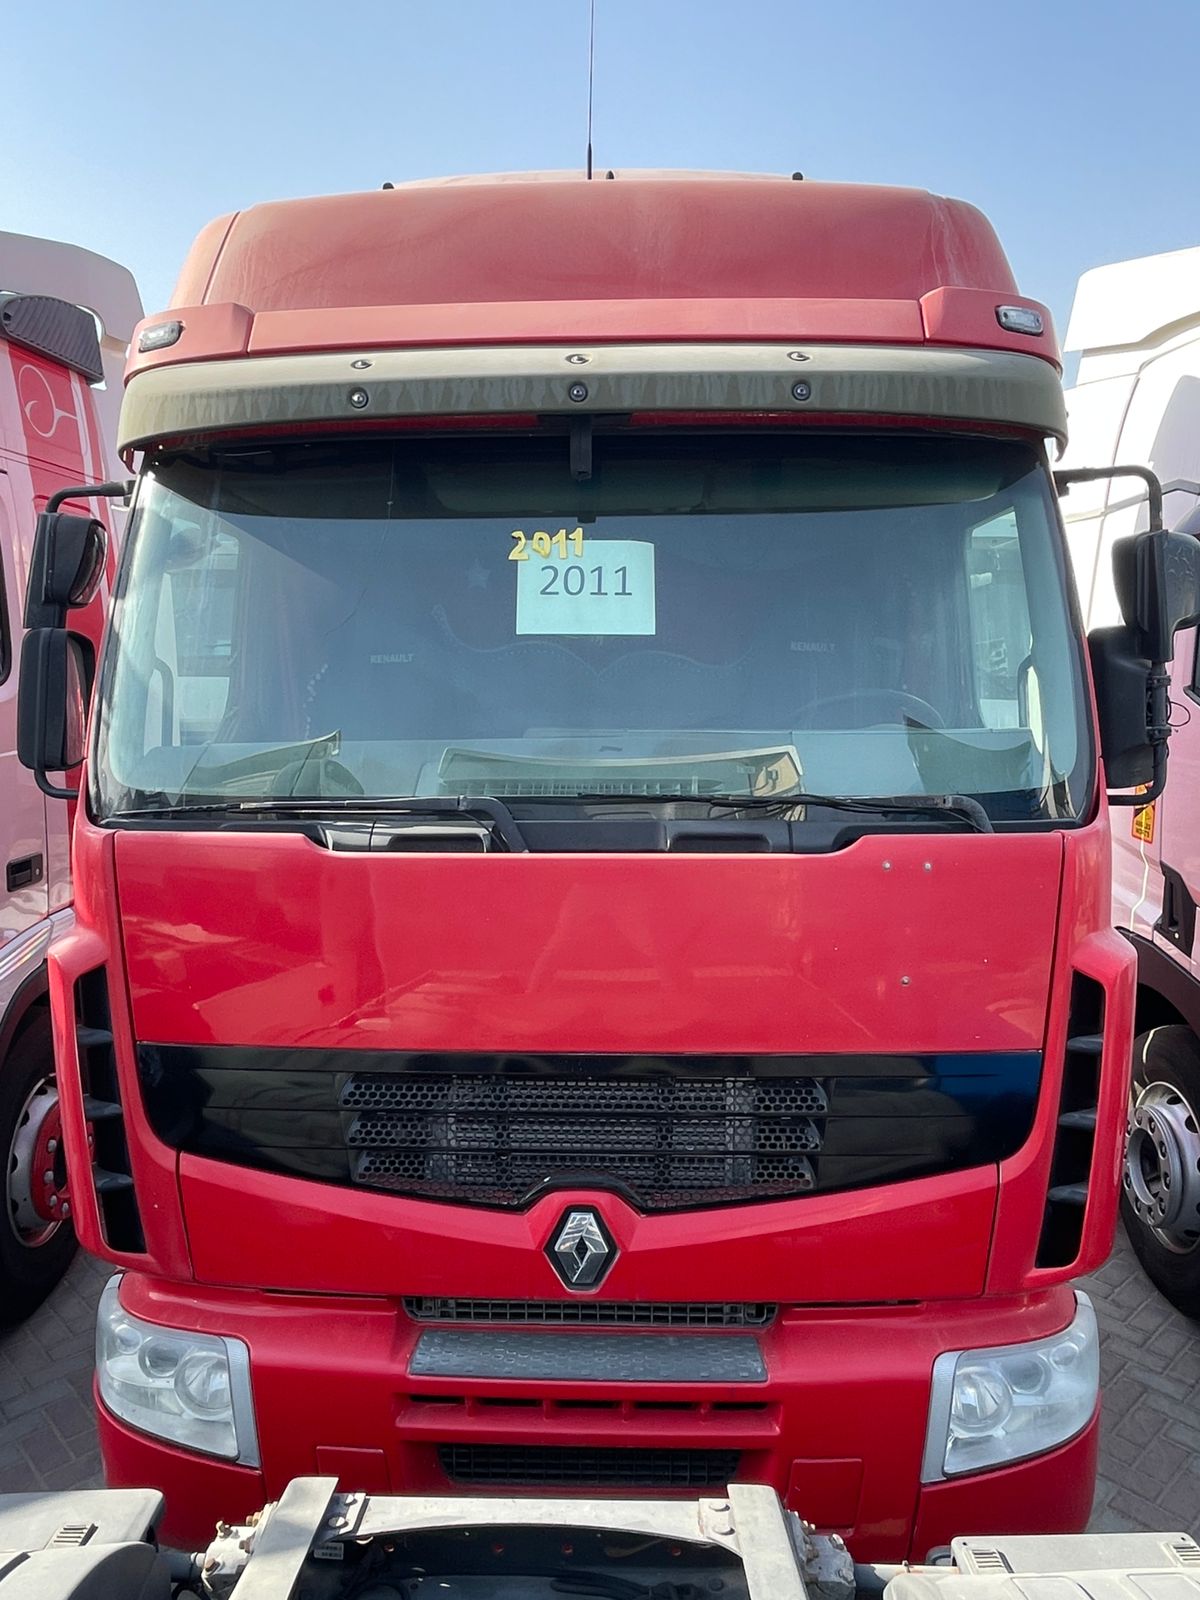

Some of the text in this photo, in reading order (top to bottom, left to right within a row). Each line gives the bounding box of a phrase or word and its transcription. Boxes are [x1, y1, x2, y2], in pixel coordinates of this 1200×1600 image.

[508, 527, 583, 560] 2011
[540, 565, 632, 596] 2011
[370, 653, 414, 664] RENAULT
